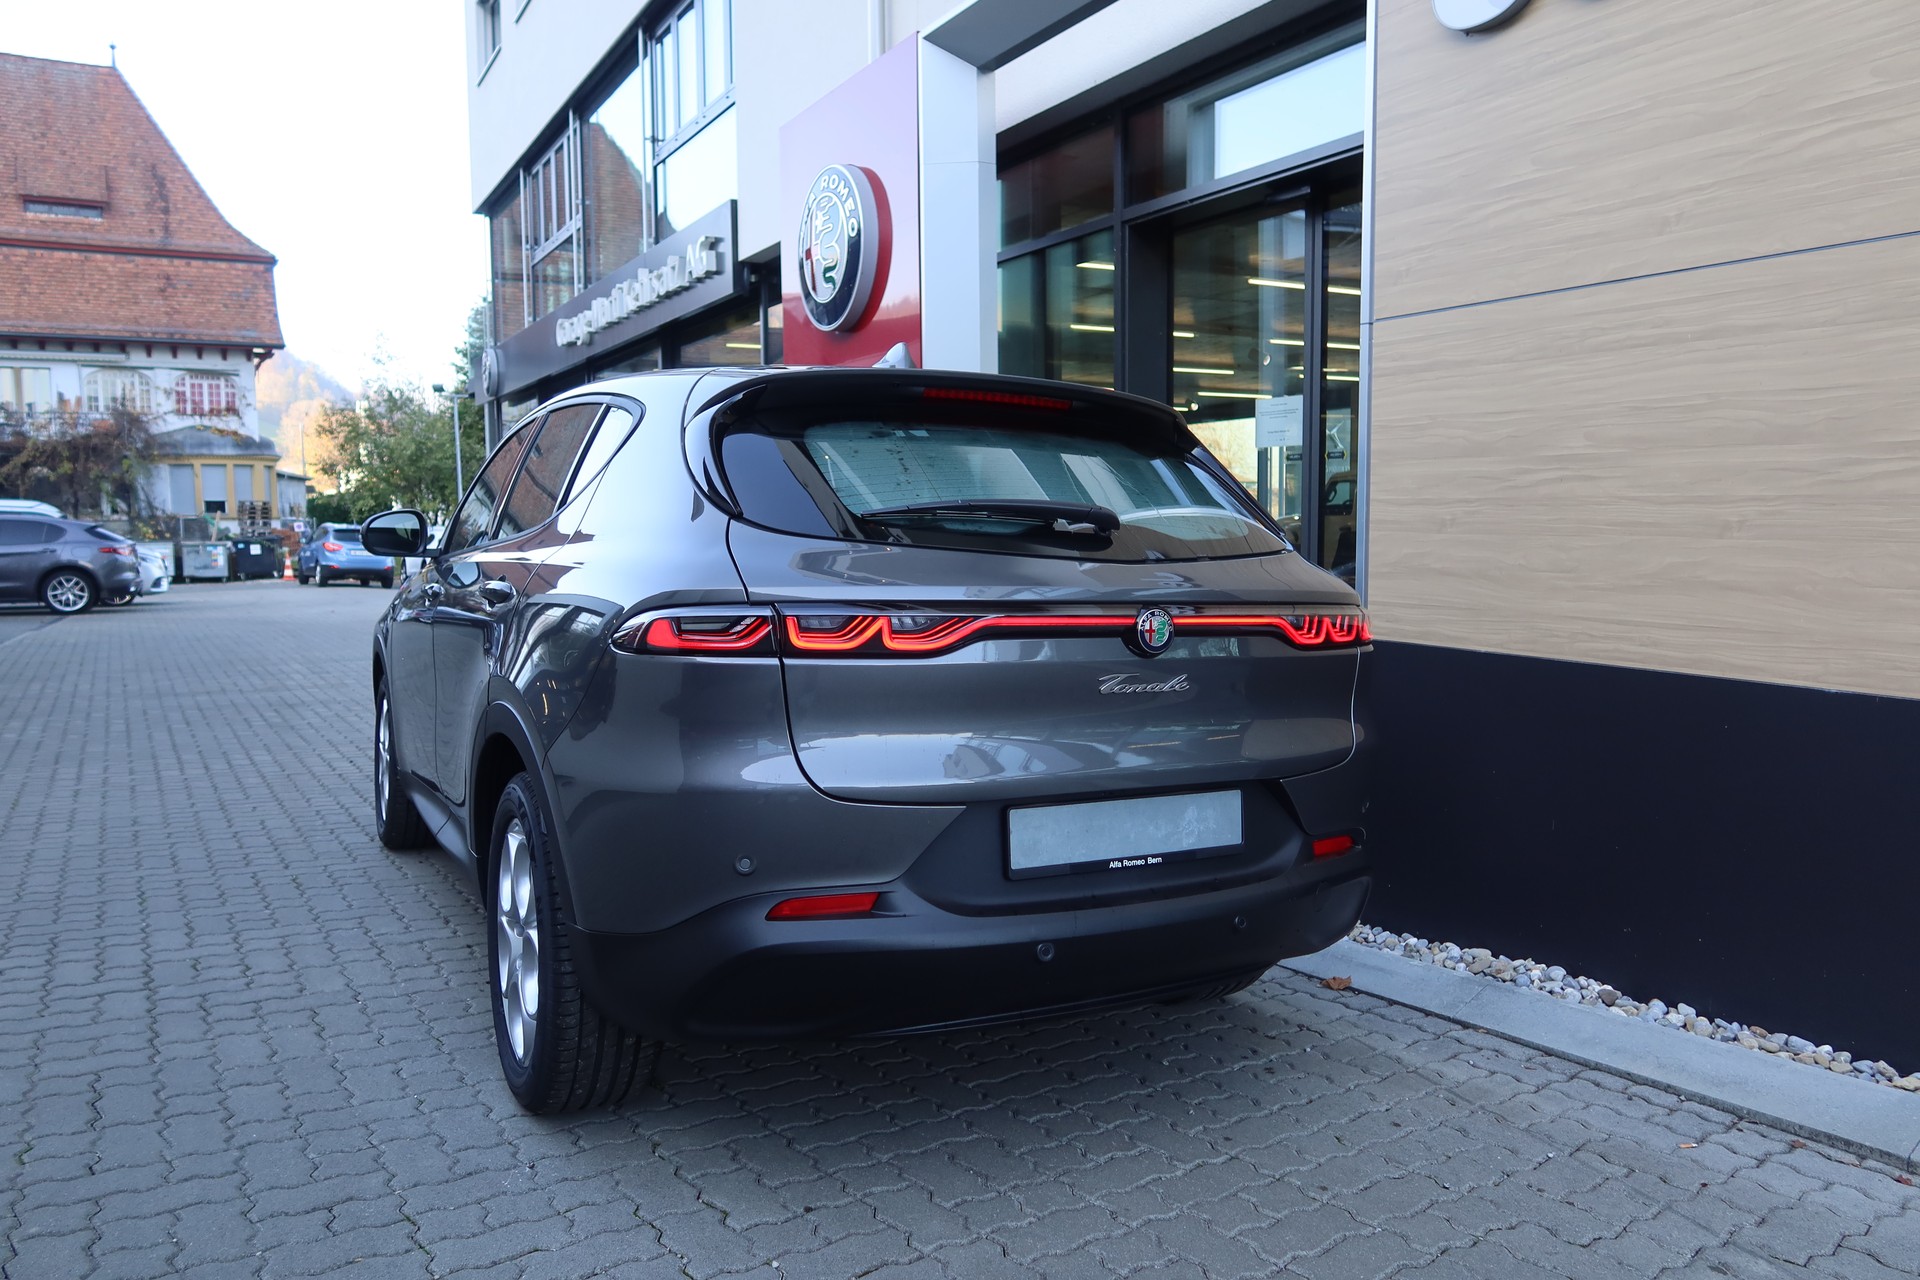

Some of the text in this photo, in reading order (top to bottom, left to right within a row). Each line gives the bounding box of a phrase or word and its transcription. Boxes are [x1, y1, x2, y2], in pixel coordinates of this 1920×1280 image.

[820, 174, 858, 237] ROMEO
[685, 236, 717, 283] AG
[1098, 673, 1190, 694] Tonale
[1109, 857, 1162, 869] Alfa Romeo Bern
